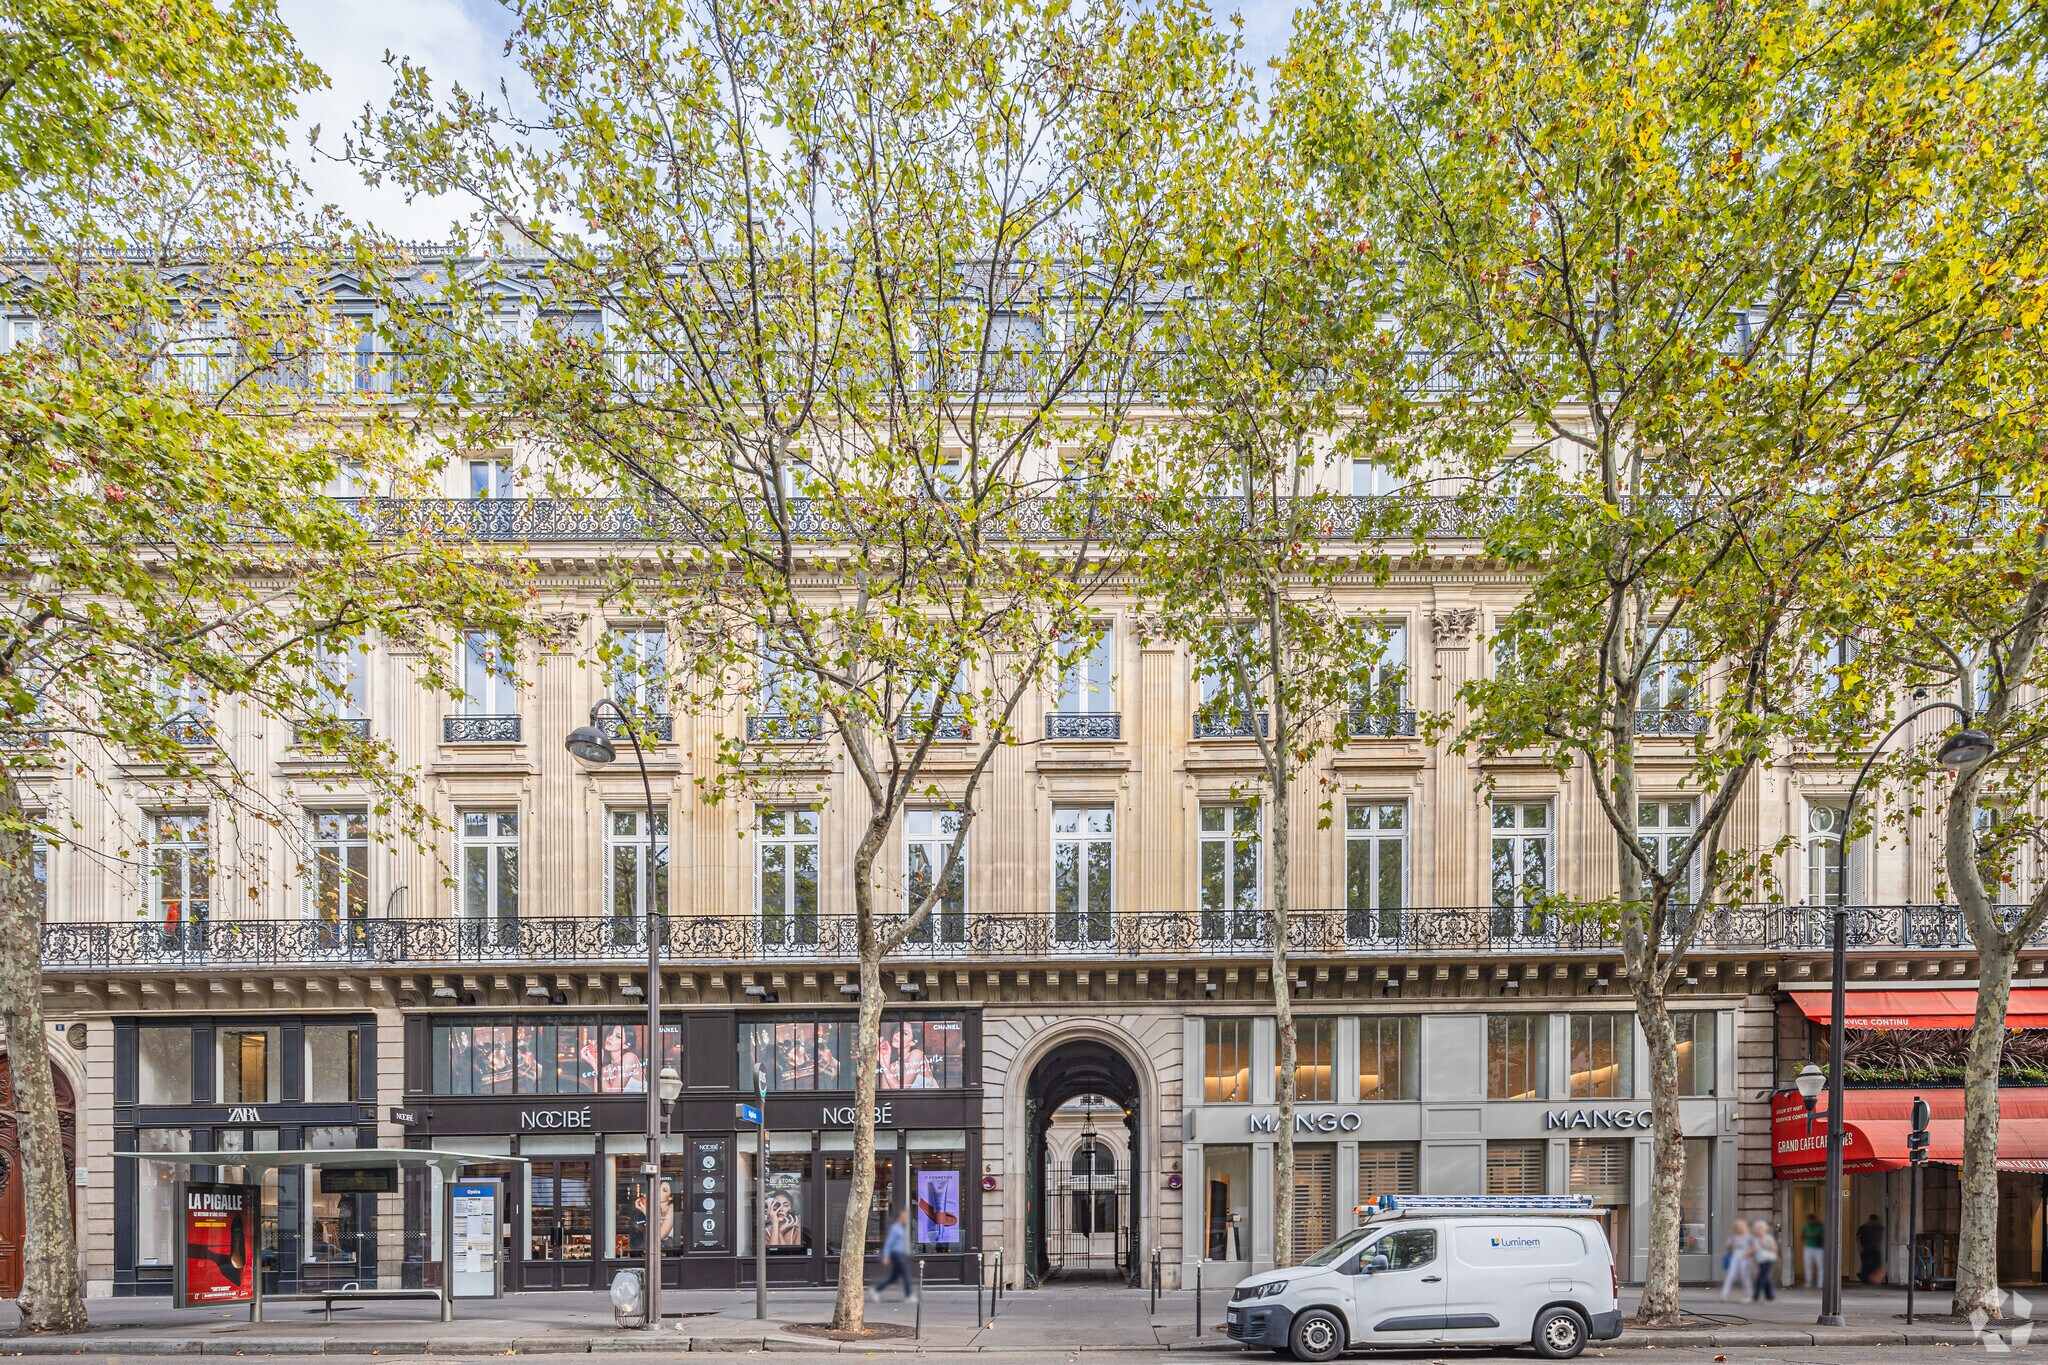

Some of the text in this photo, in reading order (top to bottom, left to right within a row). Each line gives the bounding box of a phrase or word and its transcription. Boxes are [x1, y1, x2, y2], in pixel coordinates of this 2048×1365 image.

[228, 1107, 262, 1122] ZARA
[396, 1112, 414, 1122] NOCIBÉ
[521, 1106, 591, 1128] NOCIBÉ
[823, 1102, 892, 1124] NOBÉ
[1547, 1109, 1653, 1130] MANGO
[1792, 1113, 1808, 1121] CONTIN
[1778, 1139, 1799, 1153] GRAND
[1800, 1137, 1815, 1150] CAFE
[986, 1164, 991, 1173] 6
[1172, 1161, 1178, 1170] 6
[188, 1192, 243, 1211] LA PIGALLE
